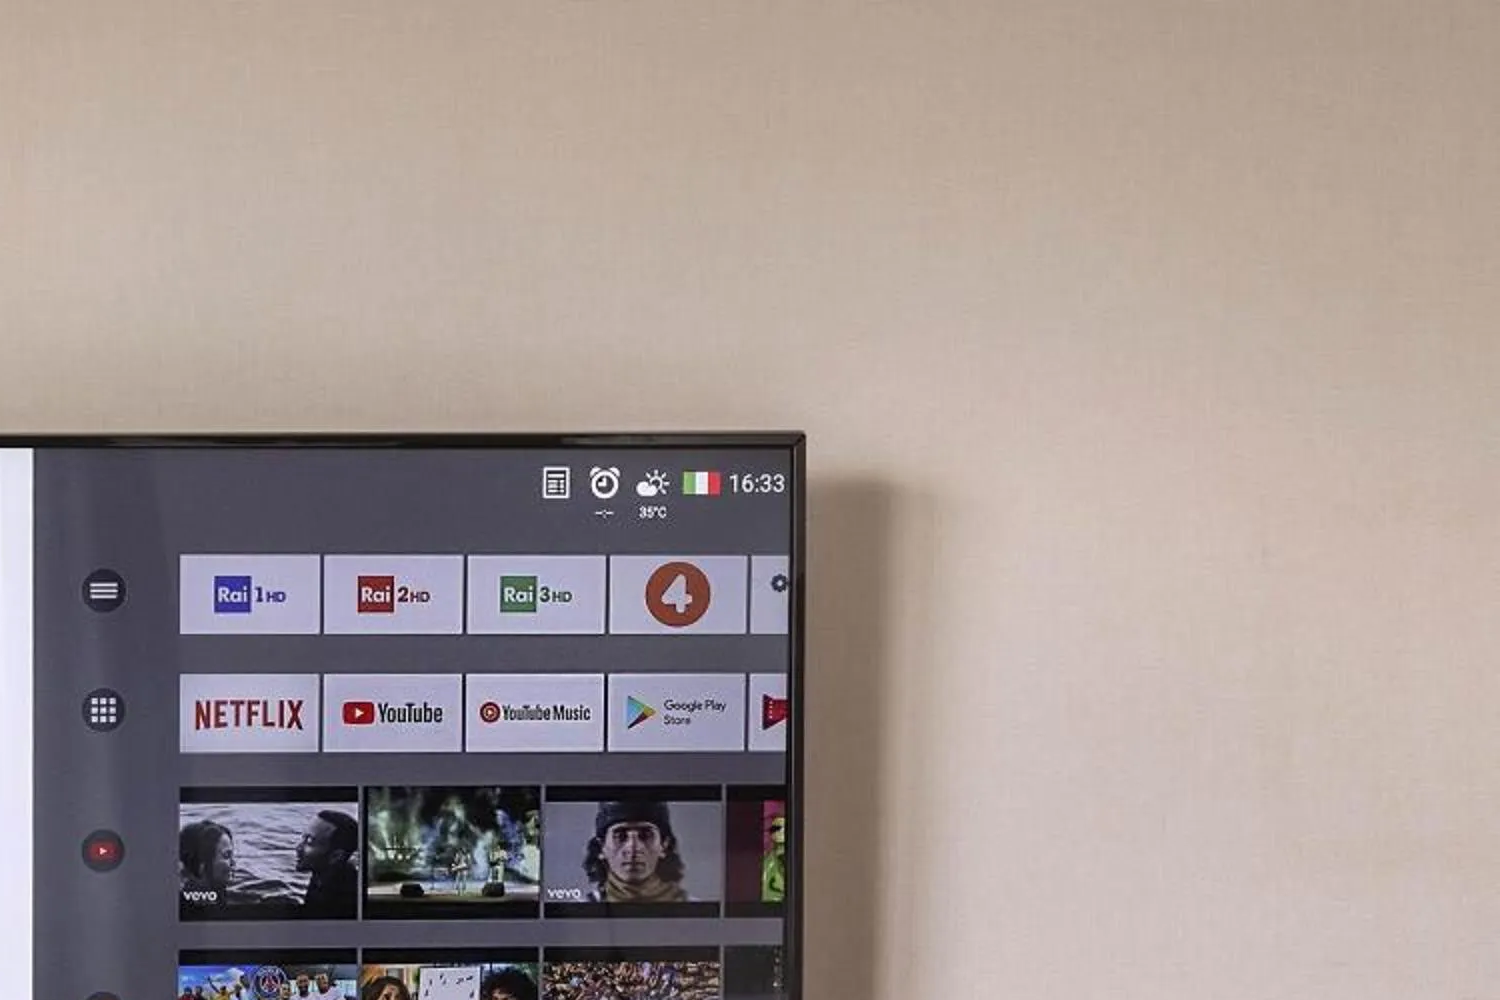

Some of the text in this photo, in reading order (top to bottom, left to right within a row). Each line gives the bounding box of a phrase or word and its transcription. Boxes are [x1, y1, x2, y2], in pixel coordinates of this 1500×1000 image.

[729, 473, 786, 493] 16:33
[217, 586, 249, 602] Rai
[360, 586, 392, 602] Rai
[503, 586, 534, 602] Rai
[660, 573, 693, 614] 4
[377, 702, 443, 723] YouTube
[501, 704, 591, 721] YouTube Music
[663, 699, 727, 714] Google Play
[195, 700, 304, 730] NETFLIX
[663, 714, 692, 726] Store
